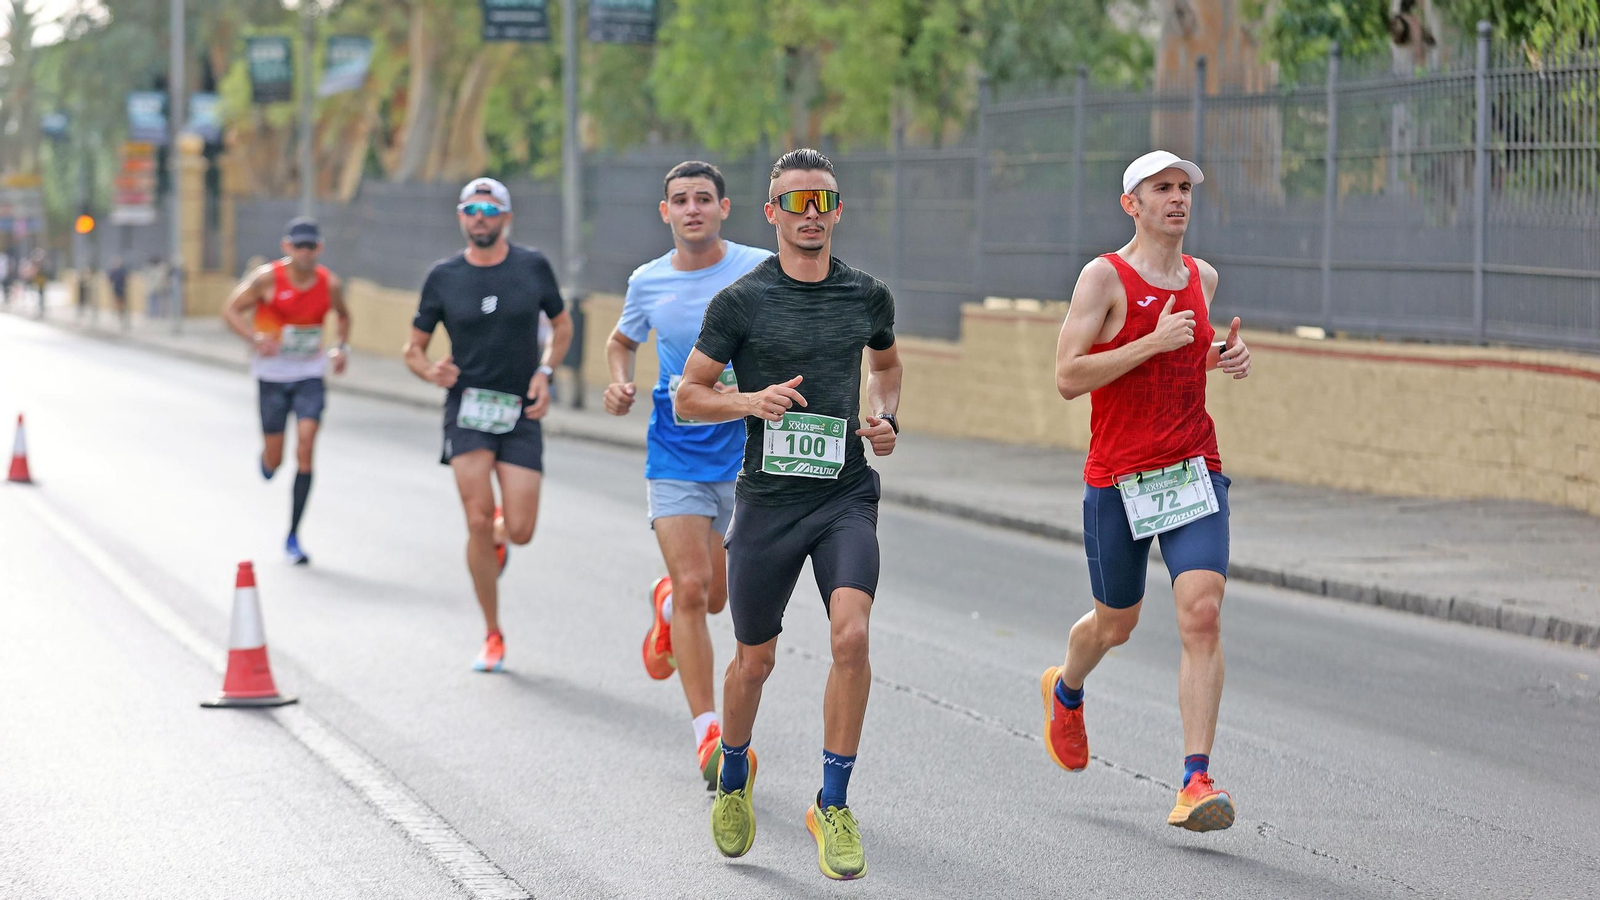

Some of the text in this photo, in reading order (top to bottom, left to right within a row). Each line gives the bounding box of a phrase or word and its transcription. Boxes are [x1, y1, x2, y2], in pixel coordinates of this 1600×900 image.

[788, 421, 810, 431] XXIX
[785, 434, 826, 458] 100
[1144, 481, 1165, 493] XXIX
[1151, 490, 1181, 512] 72
